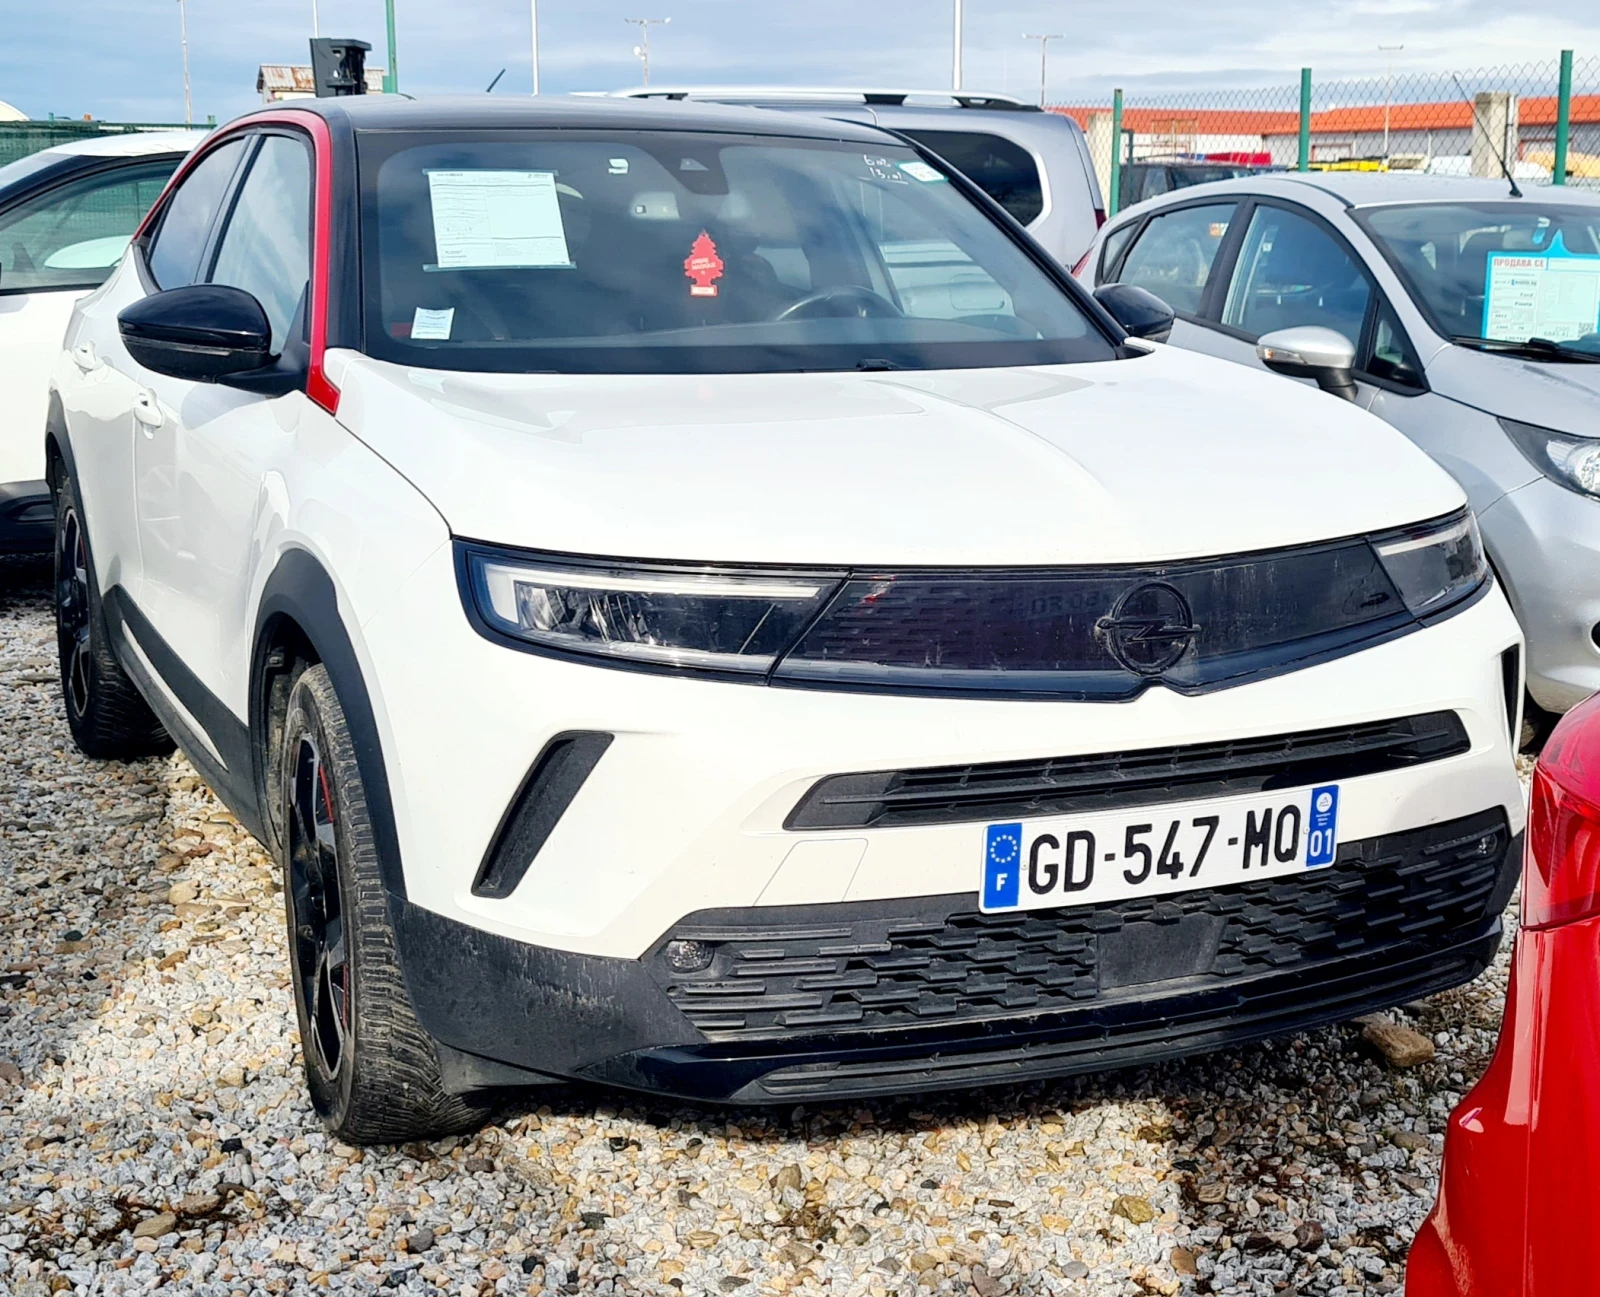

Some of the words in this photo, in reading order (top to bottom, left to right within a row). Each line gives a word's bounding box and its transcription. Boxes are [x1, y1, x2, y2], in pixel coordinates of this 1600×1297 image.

[1493, 258, 1533, 268] ПРОДАВА
[1534, 259, 1545, 268] СЕ
[1028, 804, 1301, 895] GD-547-MQ
[1309, 827, 1333, 858] 01
[995, 872, 1008, 892] F
